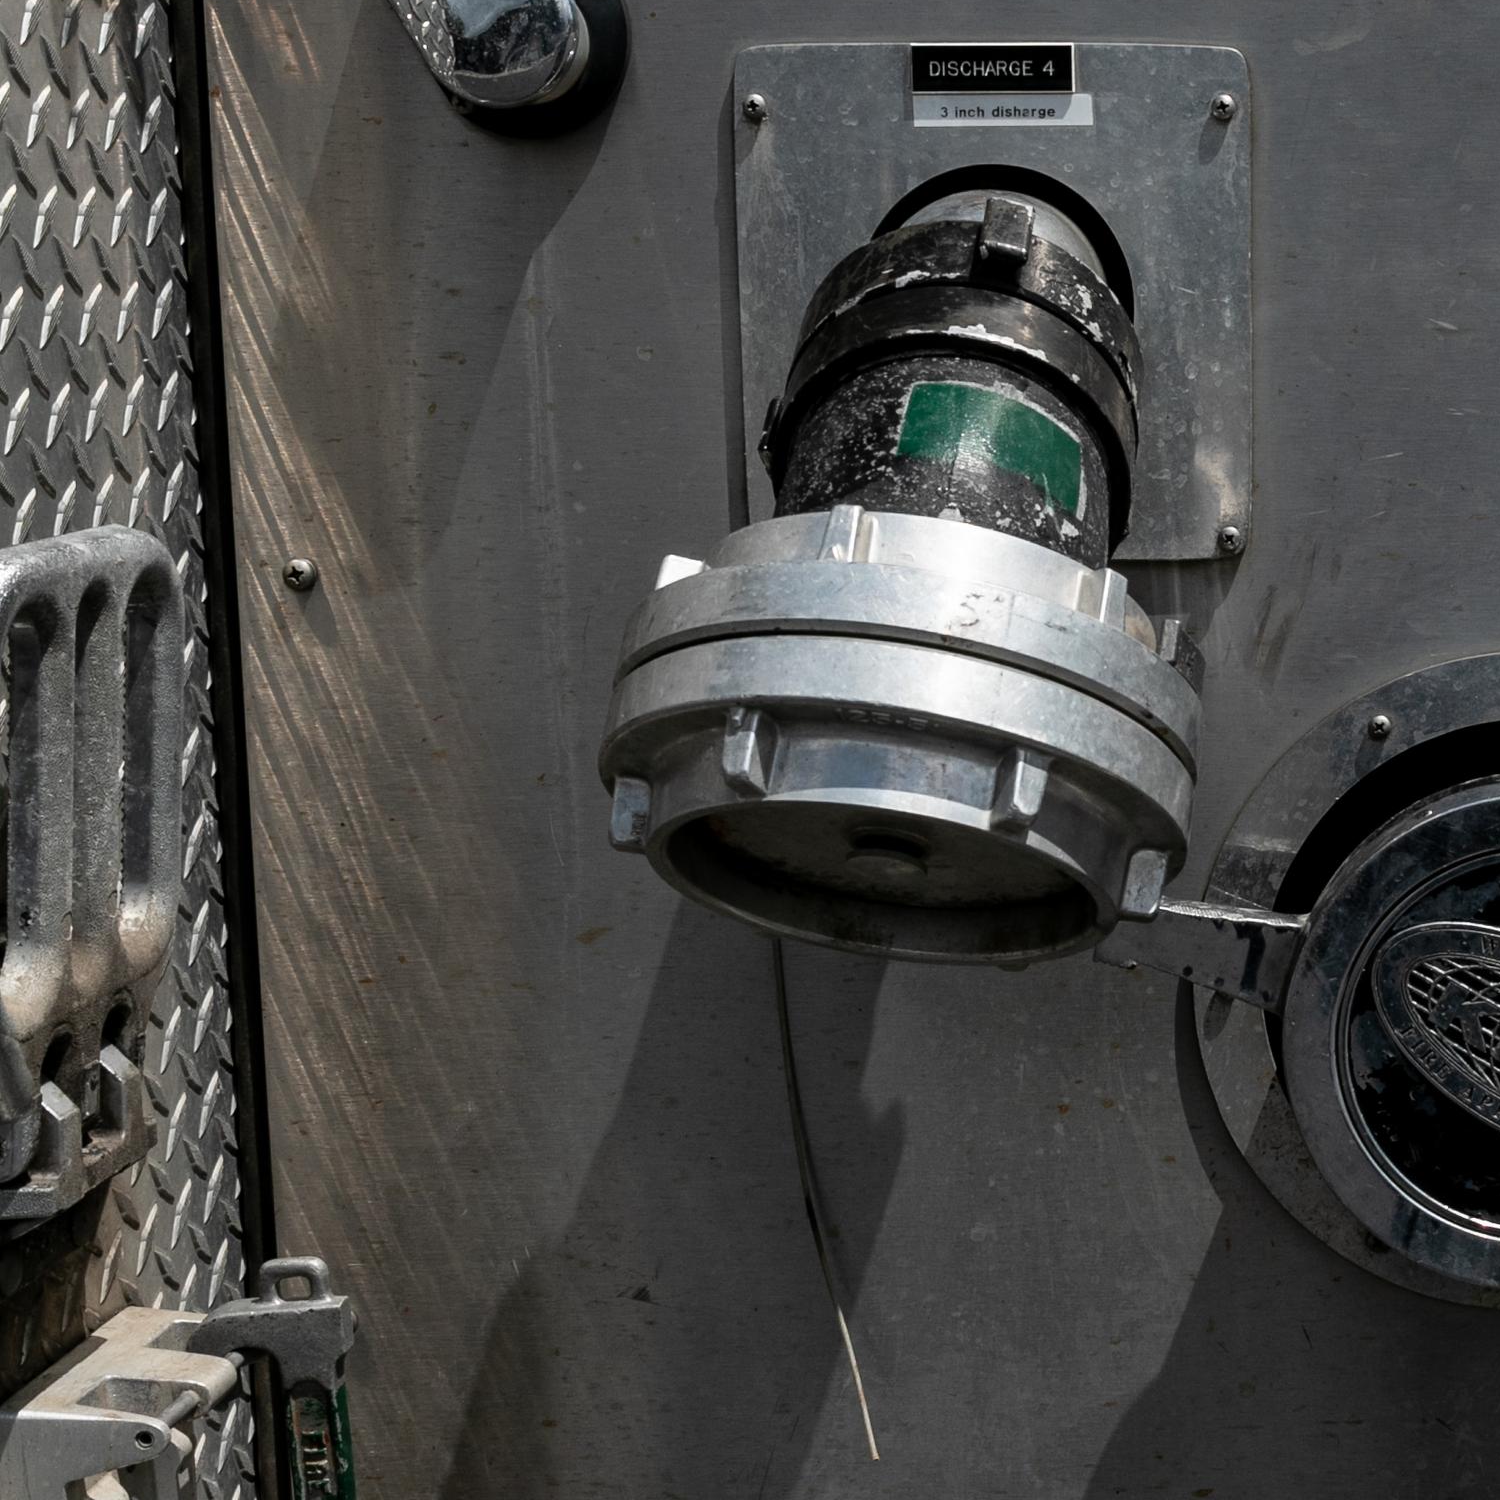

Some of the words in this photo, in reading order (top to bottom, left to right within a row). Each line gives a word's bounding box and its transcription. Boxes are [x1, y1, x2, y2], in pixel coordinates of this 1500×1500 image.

[929, 60, 1033, 77] DISCHARGE
[1042, 60, 1055, 77] 4
[940, 106, 949, 118] 3
[954, 105, 985, 118] inch
[991, 105, 1056, 120] disharge
[1394, 1026, 1451, 1080] FIRE
